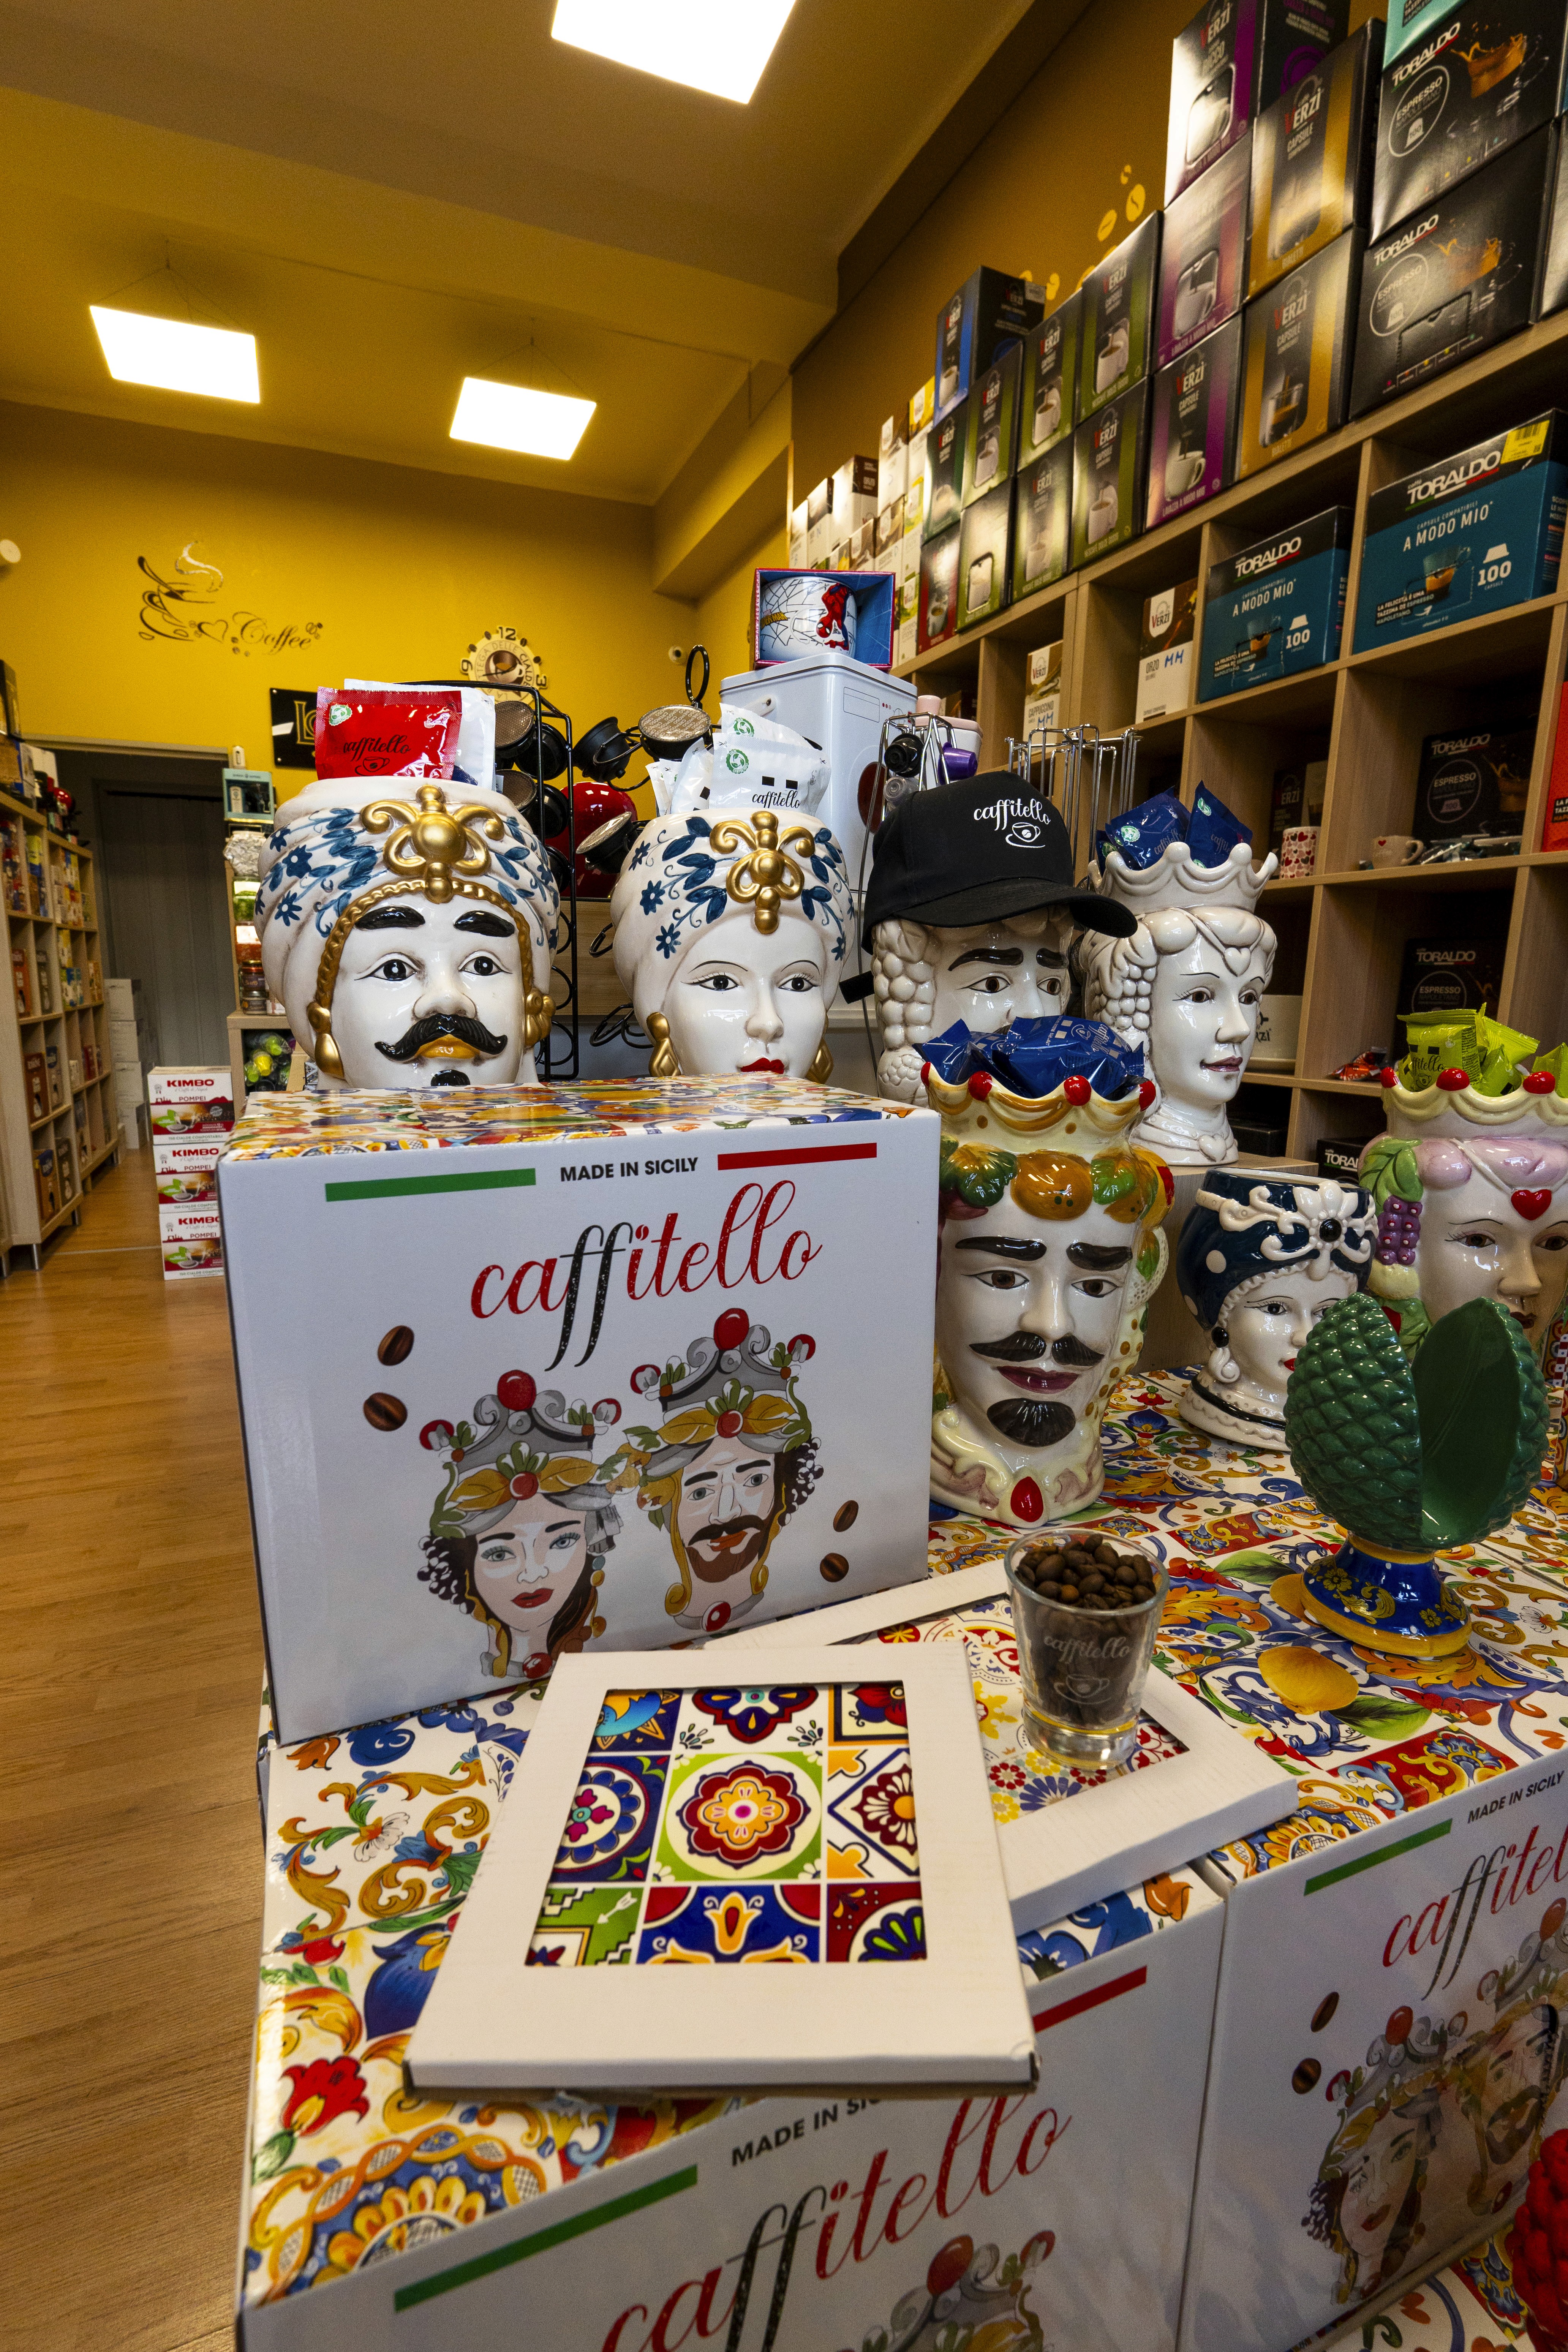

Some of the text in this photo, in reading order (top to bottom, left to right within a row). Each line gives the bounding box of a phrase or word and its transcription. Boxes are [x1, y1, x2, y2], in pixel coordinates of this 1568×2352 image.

[1392, 22, 1461, 86] TORALDO
[1397, 76, 1443, 121] ESPRESSO
[1374, 214, 1439, 266] TORALDO
[1378, 265, 1422, 300] ESPRESSO
[1407, 450, 1501, 504] TORALDO
[1417, 501, 1478, 530] CAPSULE COMPATIBILI
[1403, 536, 1411, 552] A
[1416, 518, 1456, 547] MODO
[1235, 536, 1302, 577] TORALDO
[1478, 561, 1511, 586] 100
[1233, 604, 1239, 617] A
[1242, 591, 1270, 613] MODO
[232, 611, 311, 655] Coffee
[497, 626, 517, 641] 12
[1286, 629, 1310, 649] 100
[1028, 700, 1054, 718] CAPPUCCINO
[343, 735, 411, 762] caffitello
[1431, 733, 1491, 755] TORALDO
[1434, 772, 1476, 787] ESPRESSO
[752, 790, 801, 808] caffitello
[974, 798, 1051, 831] caffitello
[1416, 951, 1476, 962] TORALDO
[1413, 1055, 1446, 1076] ffitello
[172, 1148, 219, 1157] KIMBO
[560, 1157, 698, 1182] MADE IN SICILY
[470, 1180, 823, 1372] caffitello
[1043, 1634, 1132, 1664] caffitello
[1468, 1770, 1564, 1823] MADE IN SICILY
[732, 2118, 805, 2166] MADE
[814, 2103, 838, 2130] IN
